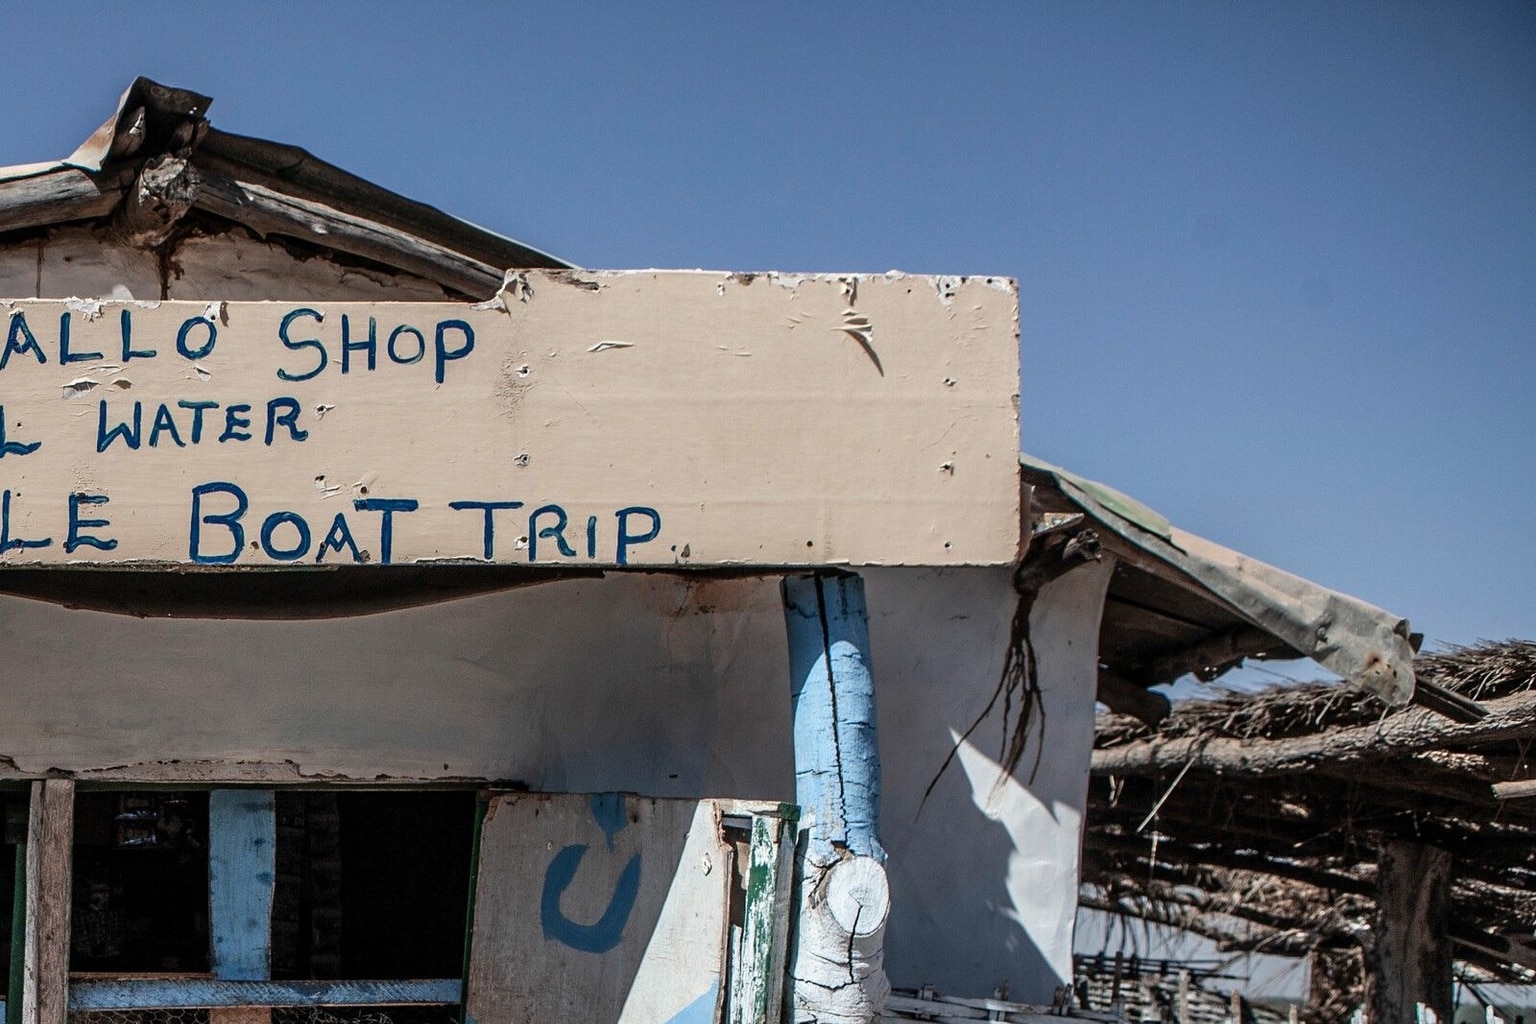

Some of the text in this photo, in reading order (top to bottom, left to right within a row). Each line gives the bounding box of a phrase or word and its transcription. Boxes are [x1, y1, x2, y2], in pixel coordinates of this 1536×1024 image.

[276, 307, 475, 384] SHOP
[96, 396, 309, 453] WATER
[188, 481, 419, 566] BOAT
